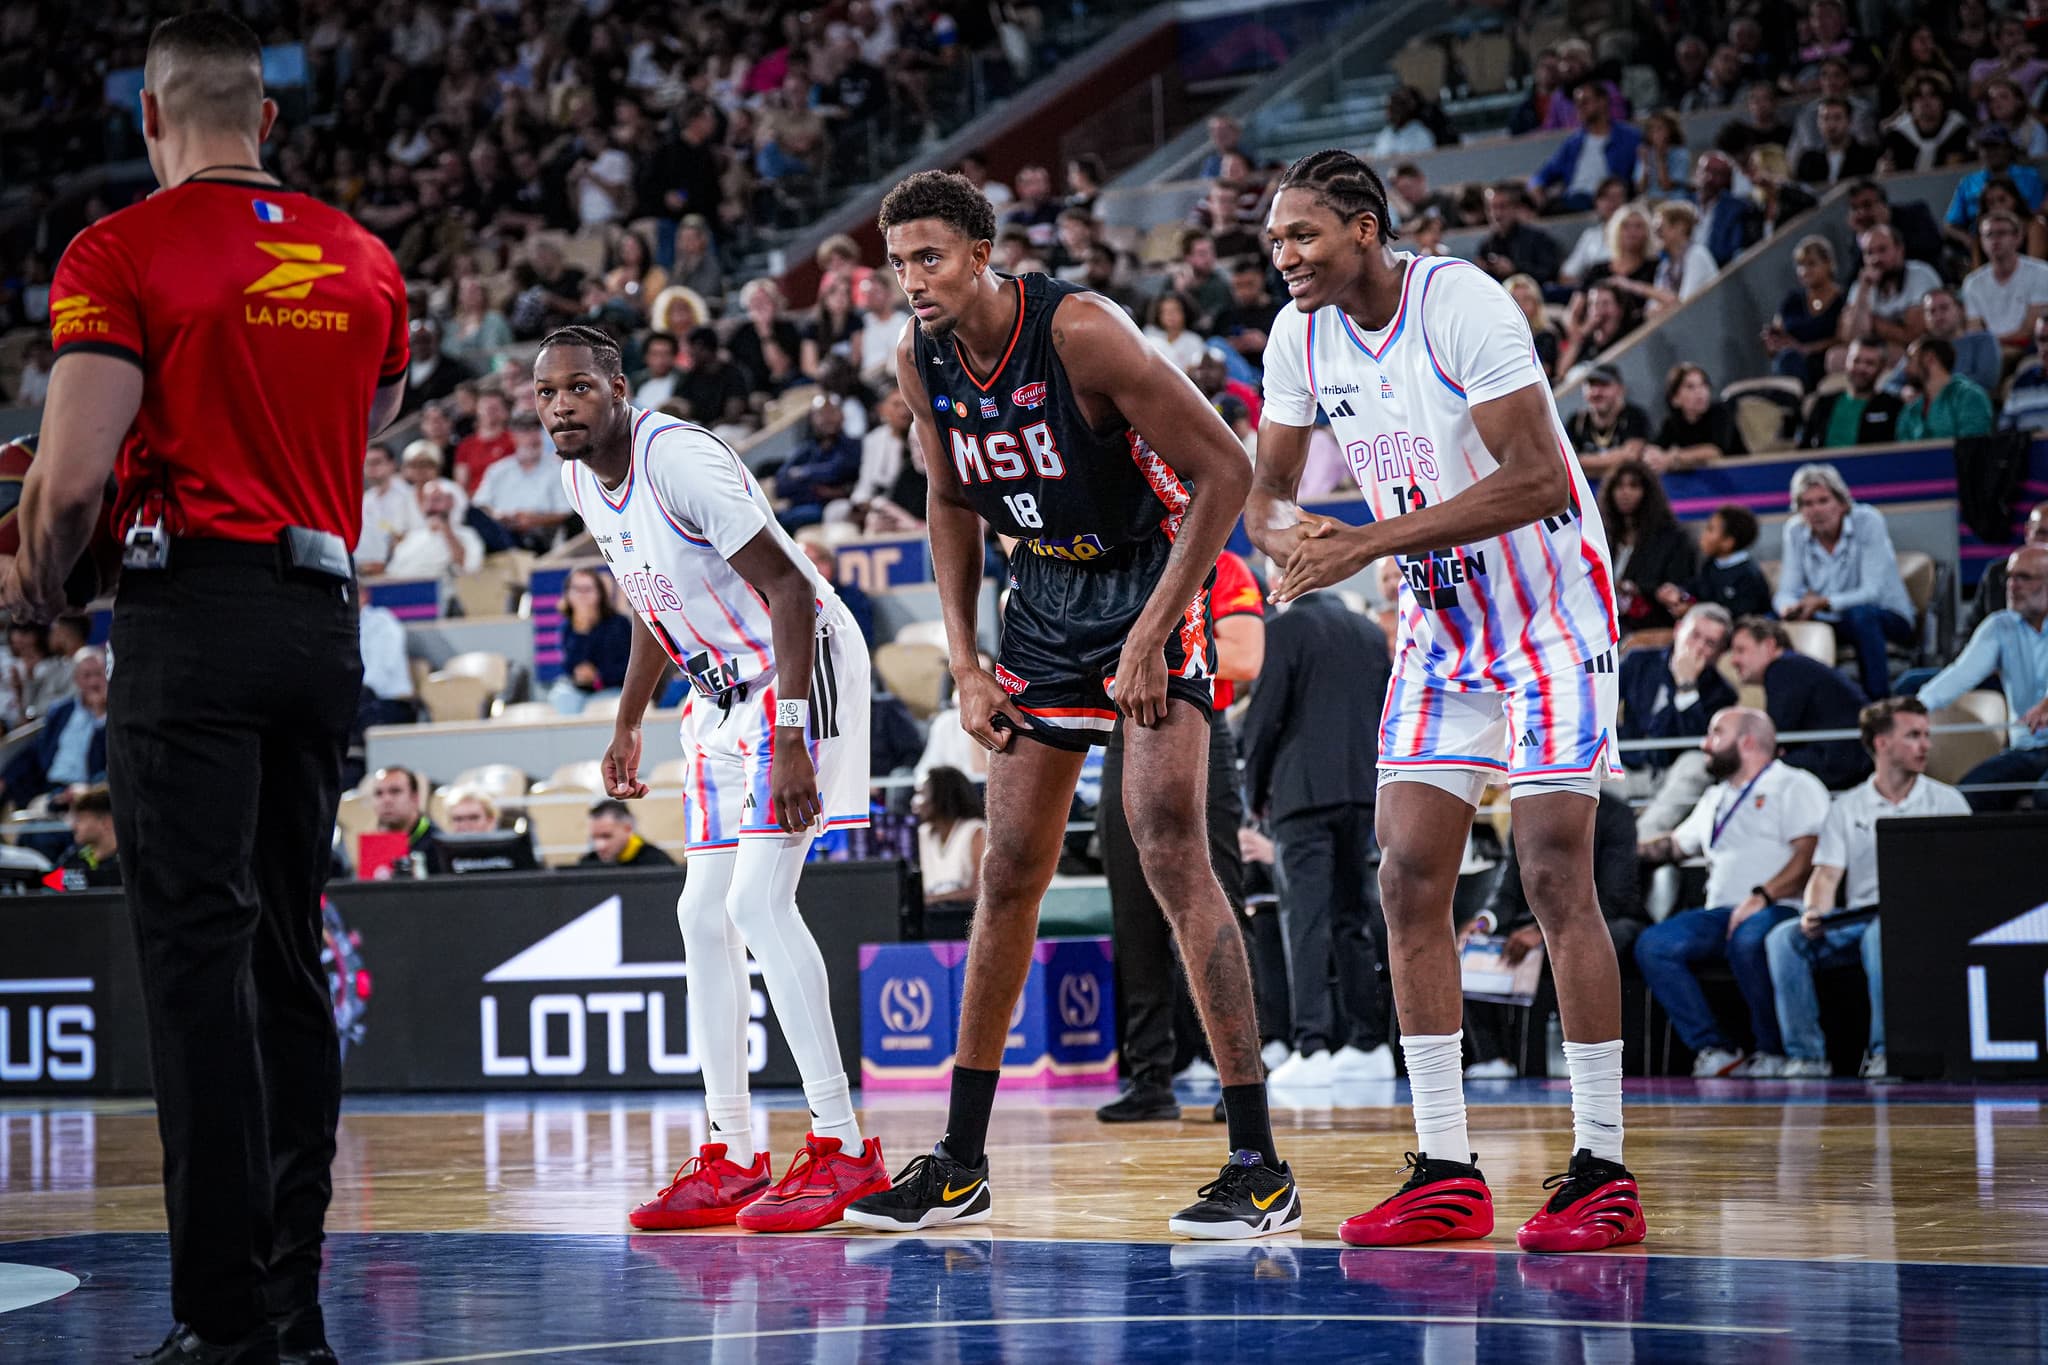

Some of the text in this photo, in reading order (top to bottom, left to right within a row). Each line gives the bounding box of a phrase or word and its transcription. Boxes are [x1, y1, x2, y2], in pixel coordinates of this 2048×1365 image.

[245, 304, 349, 332] LA POSTE
[949, 420, 1067, 486] MSB
[1346, 431, 1440, 488] PARS
[1002, 492, 1044, 529] 18
[616, 571, 683, 613] ARIS
[1967, 965, 2048, 1062] L
[0, 1004, 96, 1081] US
